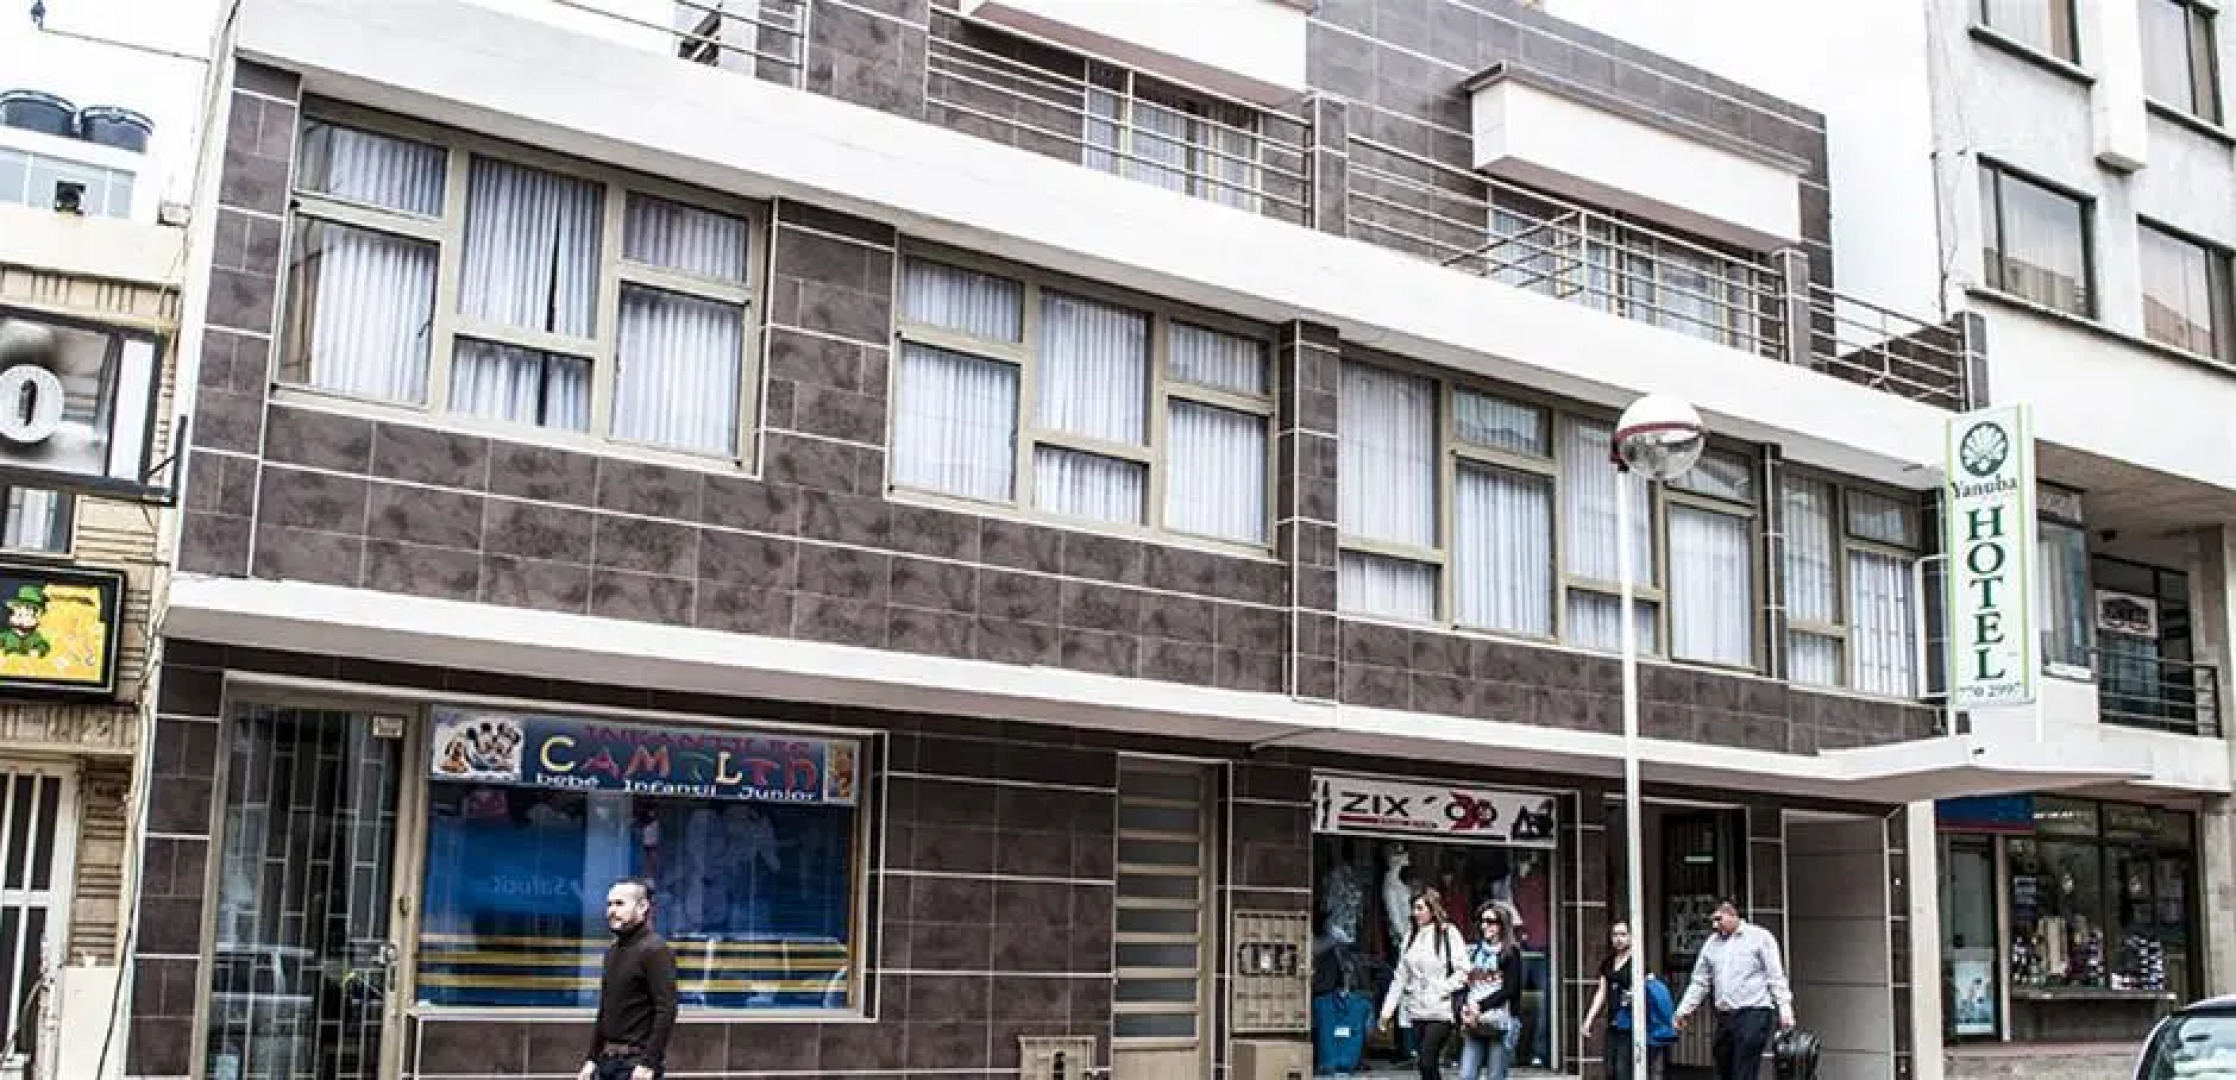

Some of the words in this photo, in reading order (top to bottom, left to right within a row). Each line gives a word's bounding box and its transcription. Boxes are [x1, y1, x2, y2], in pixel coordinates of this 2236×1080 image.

[1951, 473, 2018, 499] Yanuba
[1965, 505, 2005, 681] HOTEL
[624, 779, 717, 798] Infantil
[739, 785, 816, 800] Junior
[1341, 791, 1410, 816] ZIX
